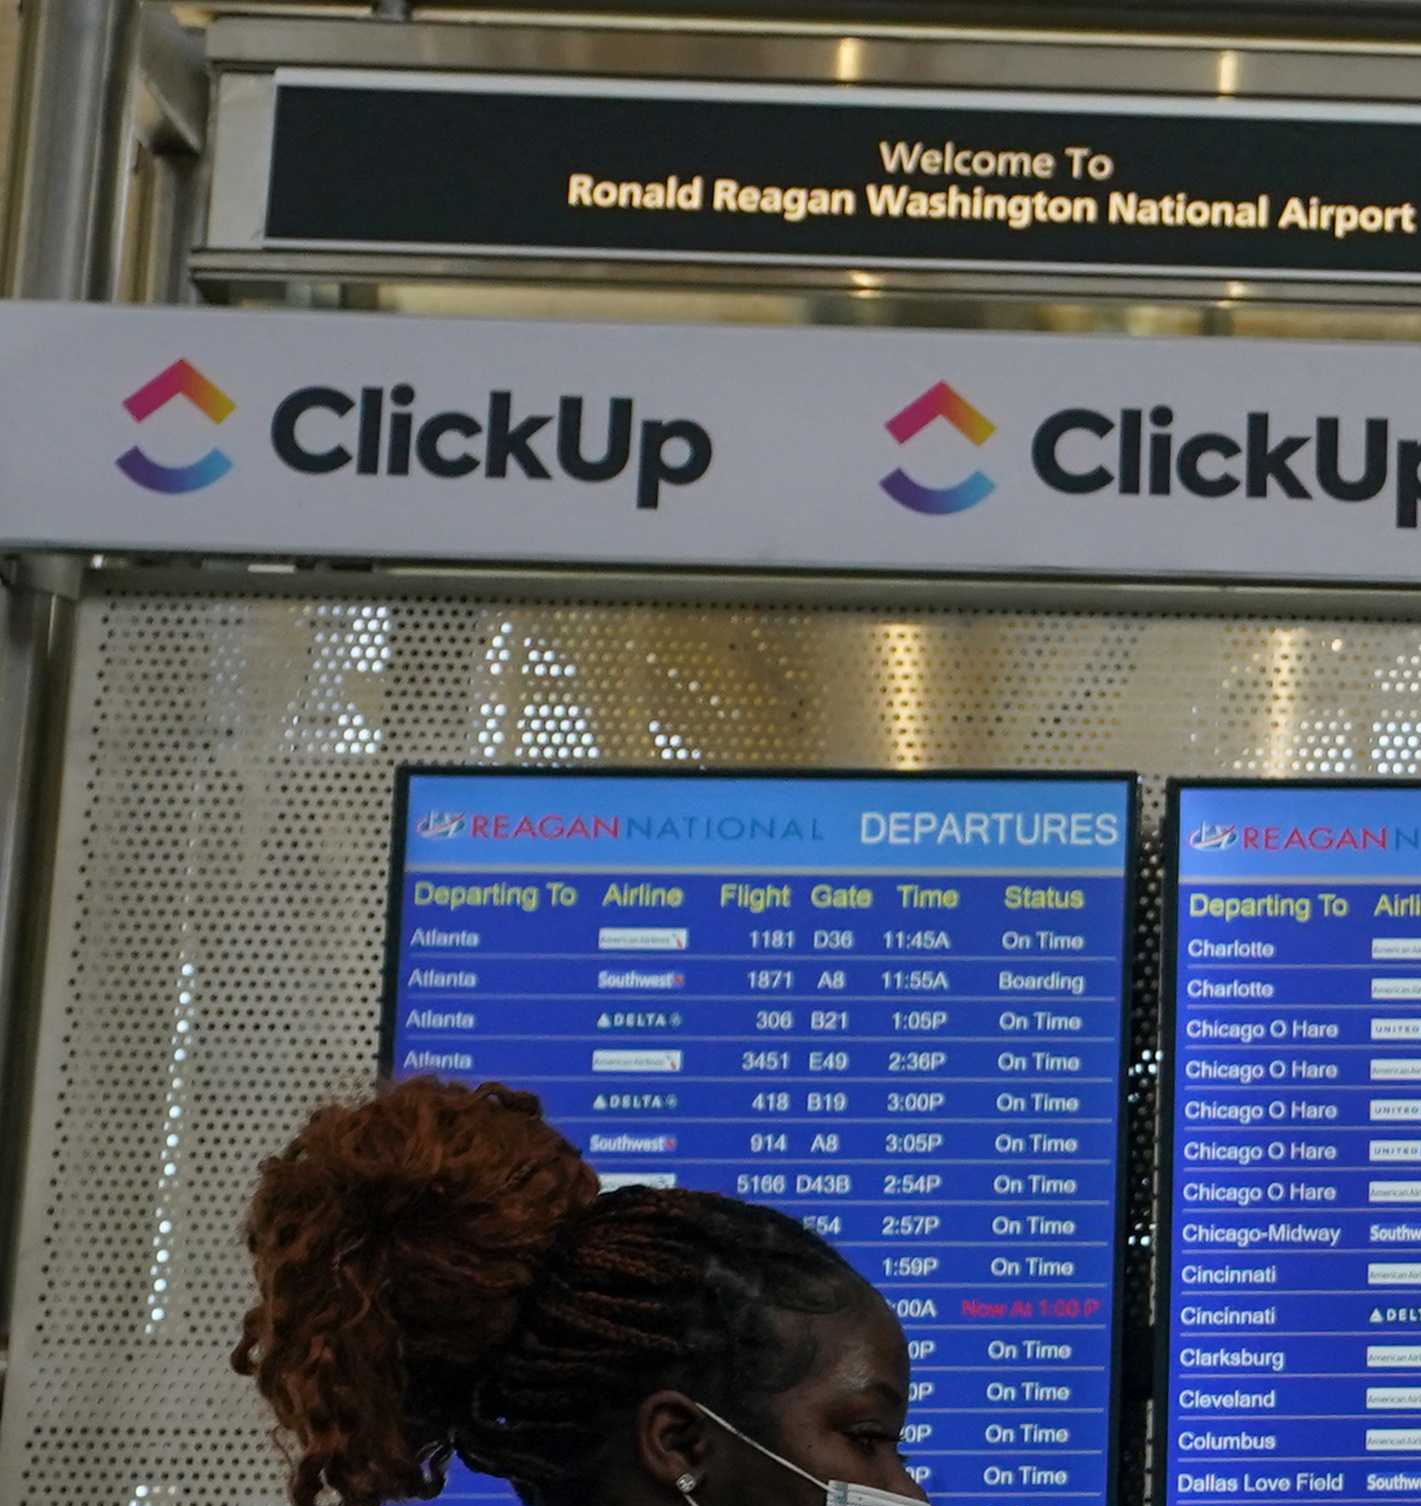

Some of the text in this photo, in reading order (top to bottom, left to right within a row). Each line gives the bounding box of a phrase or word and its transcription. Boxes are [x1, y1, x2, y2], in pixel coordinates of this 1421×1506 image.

[880, 142, 1113, 179] Welcome To
[568, 174, 1415, 237] Ronald Reagan Washington National Airport
[271, 384, 712, 510] ClickUp
[471, 815, 824, 842] REAGAN NATIONAL
[861, 812, 1119, 846] DEPARTURES
[1243, 826, 1387, 850] REAGAN
[415, 882, 1084, 913] Departing To Airline Flight Gate Time Status
[1190, 893, 1310, 922] Departing
[1318, 894, 1348, 916] To
[411, 929, 1084, 949] Atlanta 1181 D36 11:45A On Time
[1188, 939, 1274, 957] Charlotte
[408, 969, 1084, 994] Atlanta Southwest 1871 A8 11:55A Boarding
[1183, 1224, 1340, 1247] Chicago-Midway
[1181, 1307, 1275, 1325] Cincinnati
